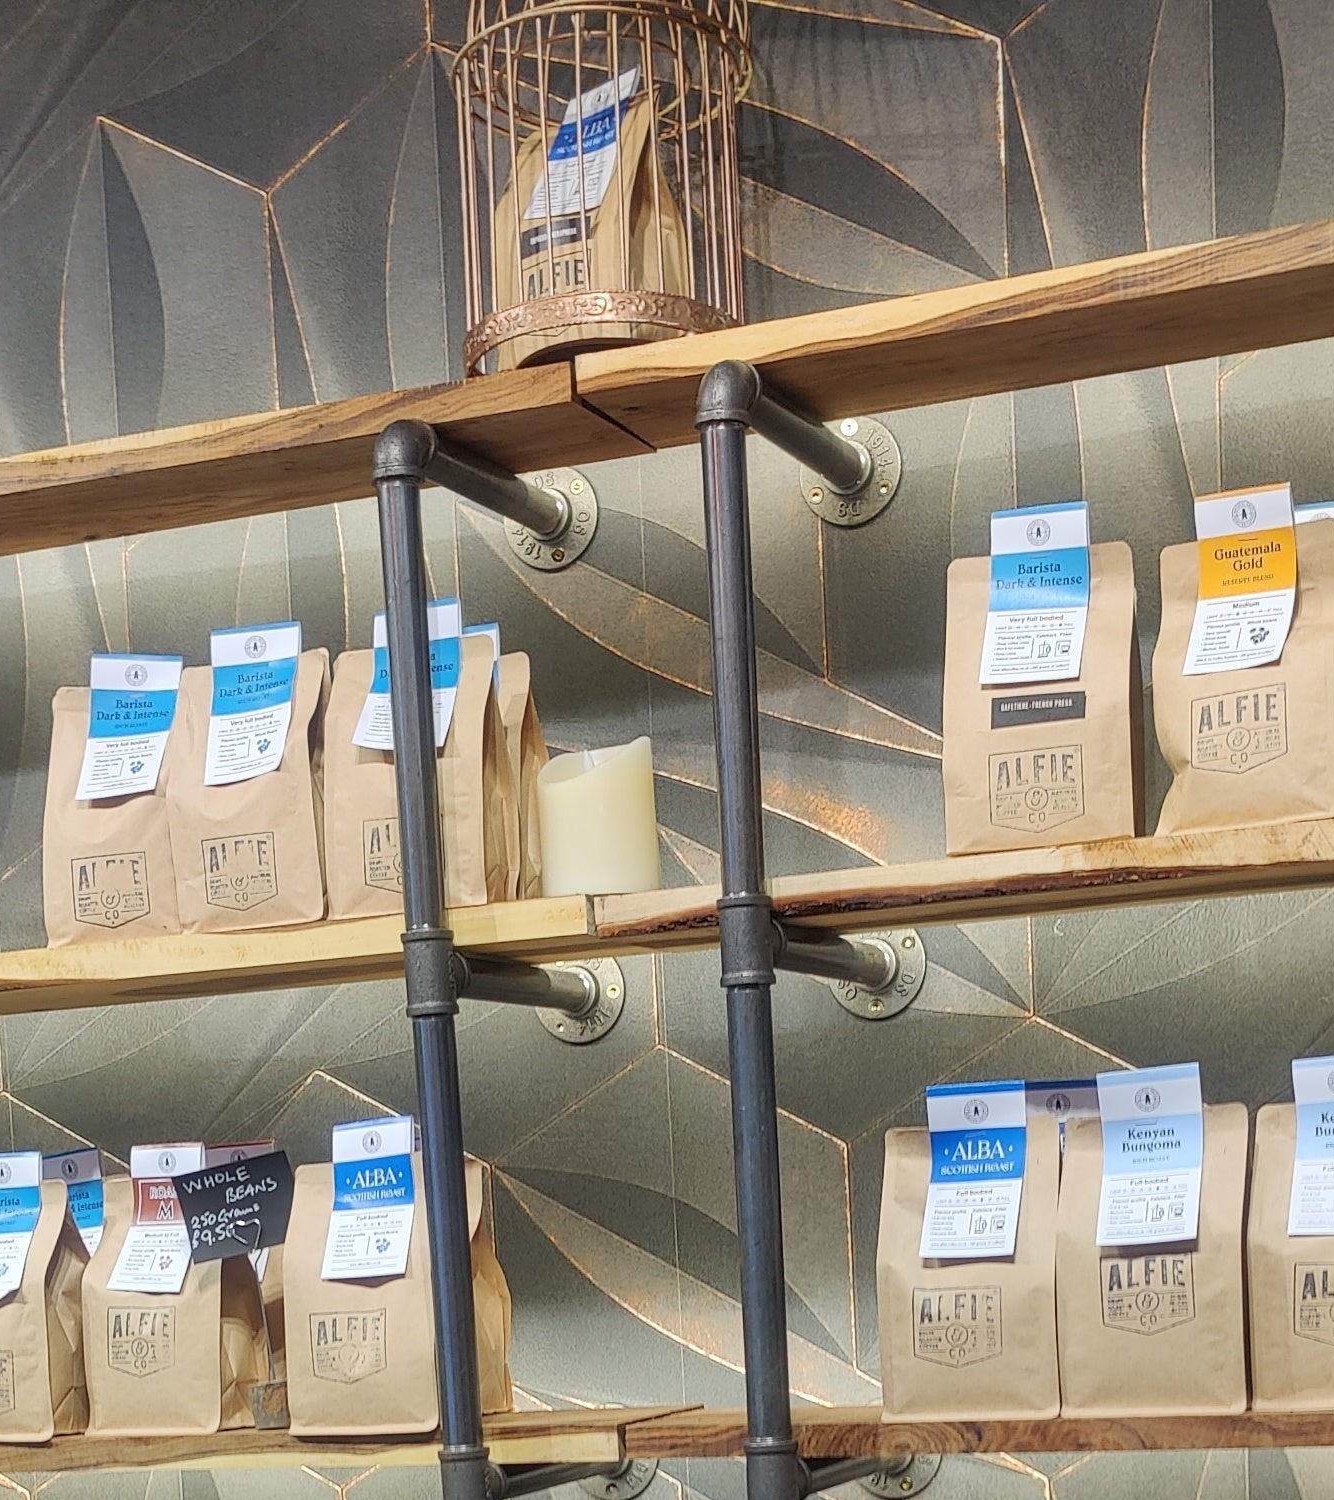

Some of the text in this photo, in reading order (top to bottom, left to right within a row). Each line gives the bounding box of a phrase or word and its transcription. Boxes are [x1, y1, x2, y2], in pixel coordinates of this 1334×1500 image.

[528, 258, 584, 298] ALFIE
[1214, 541, 1281, 560] Guatemala
[1018, 563, 1061, 575] Barista
[1233, 557, 1263, 571] Gold
[996, 576, 1083, 590] Dark & Intense
[237, 670, 274, 684] Barista
[219, 678, 289, 698] Dark & Intense
[116, 699, 153, 709] Barista
[1199, 692, 1279, 734] ALFIE
[96, 709, 170, 721] Dark & Intense
[1230, 752, 1248, 765] CO
[997, 754, 1075, 791] ALFIE
[1029, 812, 1046, 823] CO
[1128, 1127, 1175, 1140] Kenyan
[951, 1140, 1006, 1162] ALBA
[1122, 1138, 1182, 1153] Bungoma
[183, 1166, 251, 1194] WHOLE
[352, 1168, 397, 1187] ALBA
[225, 1177, 278, 1204] BEANS
[158, 1204, 174, 1221] M
[191, 1215, 217, 1230] 250
[1108, 1256, 1186, 1292] ALFIE
[920, 1292, 995, 1325] ALFIE
[113, 1313, 170, 1339] ALFIE
[317, 1317, 382, 1345] ALFIE
